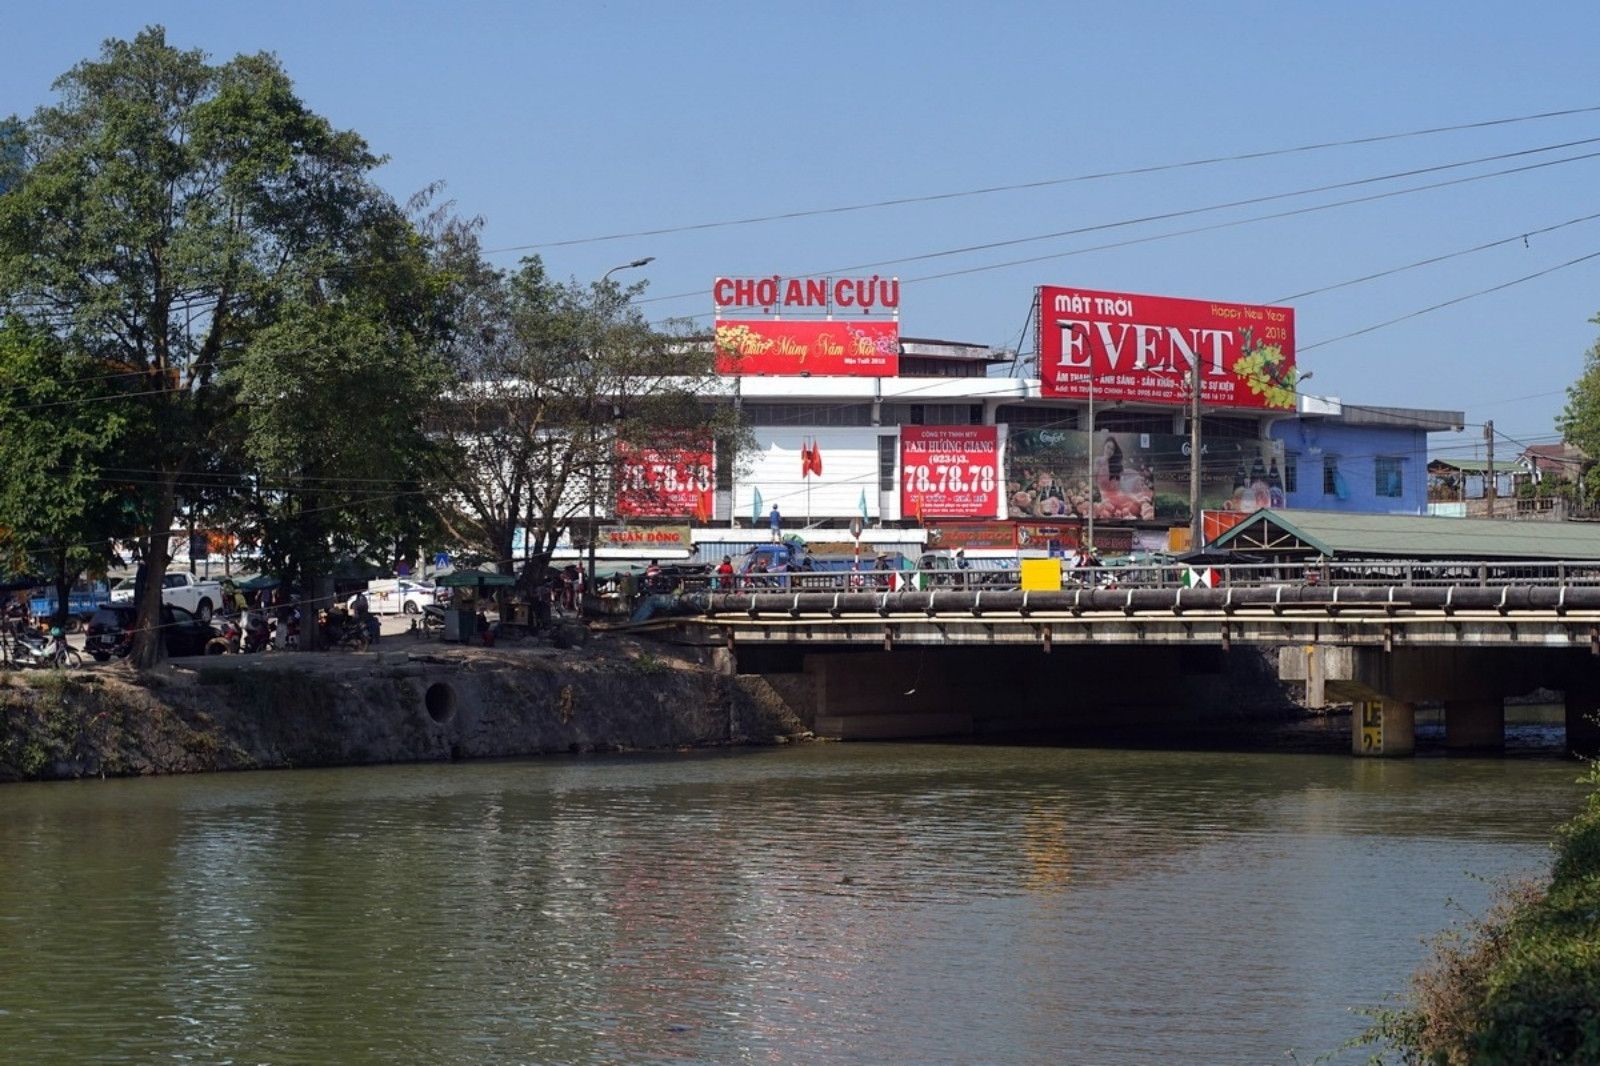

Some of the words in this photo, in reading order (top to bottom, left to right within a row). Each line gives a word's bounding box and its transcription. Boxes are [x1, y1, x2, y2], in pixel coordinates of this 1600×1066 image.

[714, 275, 780, 313] CHỢ
[784, 280, 826, 306] AN
[834, 275, 900, 314] CỰU
[1211, 304, 1241, 318] Happy
[1244, 306, 1263, 319] New
[1264, 308, 1286, 322] Year
[1265, 326, 1286, 340] 2018
[1056, 319, 1234, 376] EVENT
[905, 440, 926, 452] TAXI
[964, 440, 994, 453] GIANG
[904, 464, 994, 492] 78.78.78
